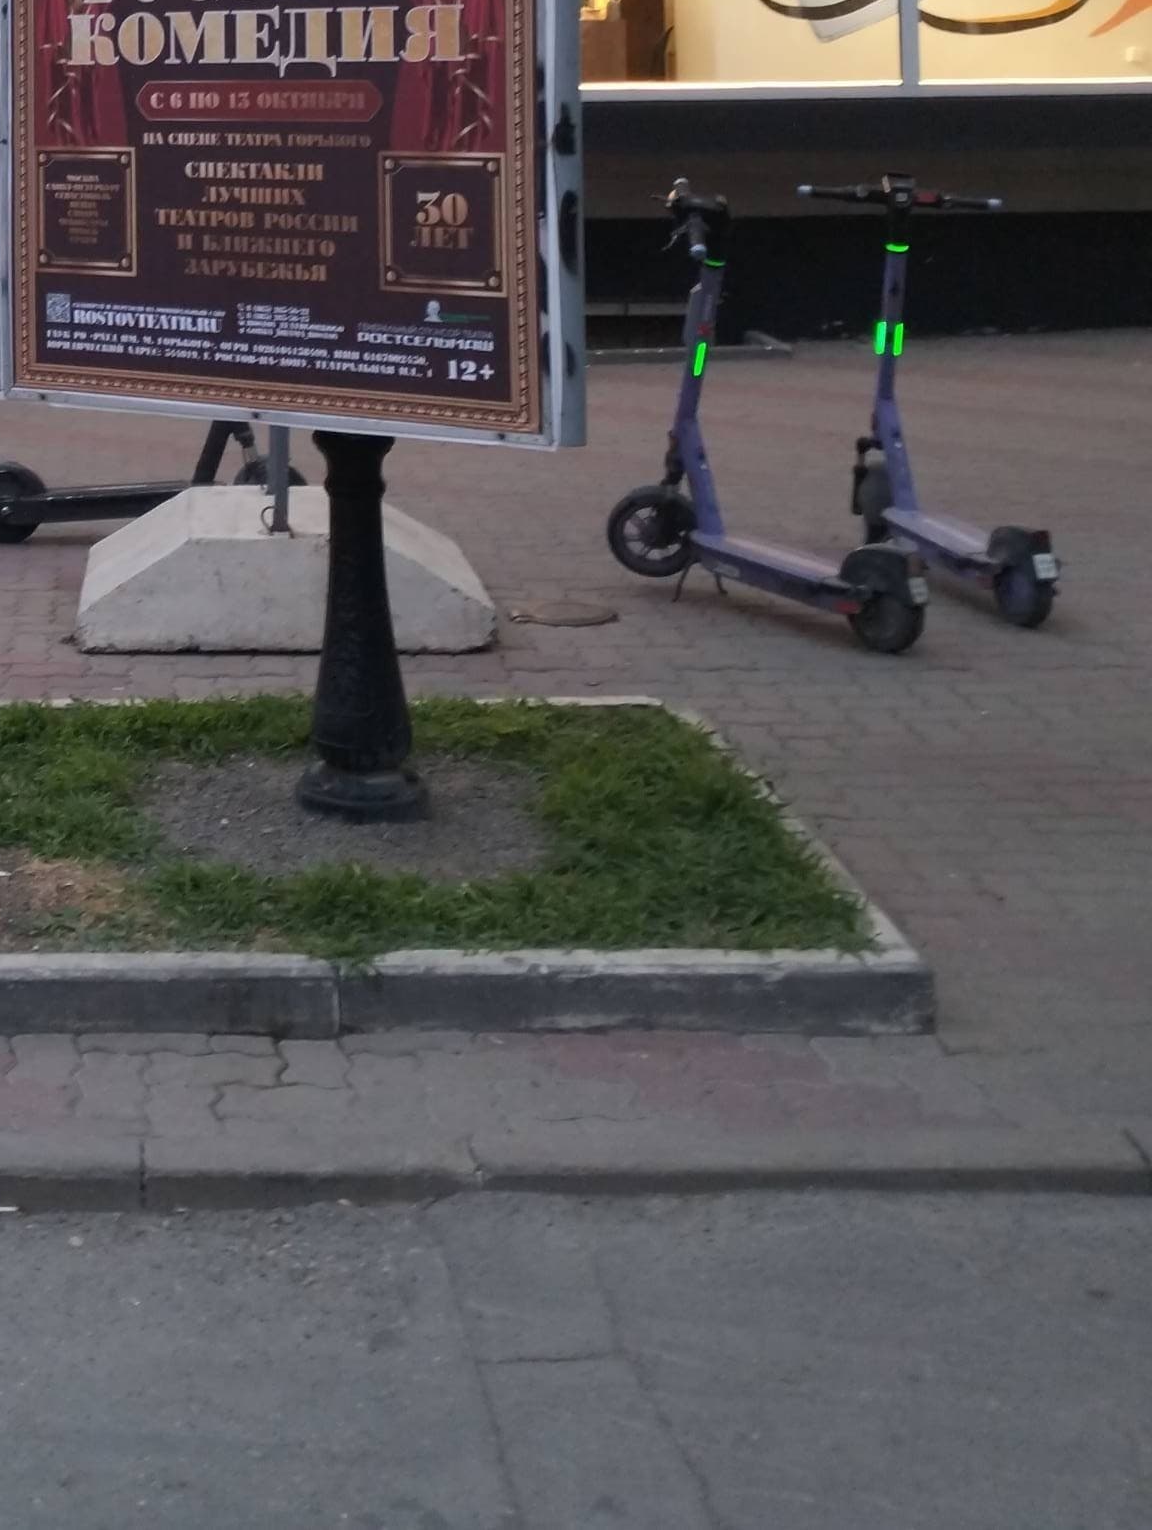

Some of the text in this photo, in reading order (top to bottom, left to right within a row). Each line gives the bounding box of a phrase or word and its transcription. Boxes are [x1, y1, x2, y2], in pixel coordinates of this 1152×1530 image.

[66, 4, 465, 77] КОМЕДИЯ
[150, 91, 165, 110] С
[169, 91, 183, 110] 6
[188, 91, 221, 110] ПО
[256, 90, 366, 110] ОКТЯБРЯ
[143, 131, 372, 148] НА СЦЕНЕ ТЕАТРА ГОРЬКОГО
[184, 161, 325, 182] СПЕКТАКЛИ
[201, 185, 306, 206] ЛУЧШИХ
[154, 208, 359, 233] ТЕАТРОВ РОССИИ
[415, 191, 469, 227] 30
[176, 233, 337, 258] И БЛИЖНЕГО
[410, 226, 475, 251] ЛЕТ
[184, 258, 328, 282] ЗАРУБЕЖЬЯ
[356, 331, 496, 352] РОСТСЕЛЬМАШ
[447, 358, 495, 382] 12+
